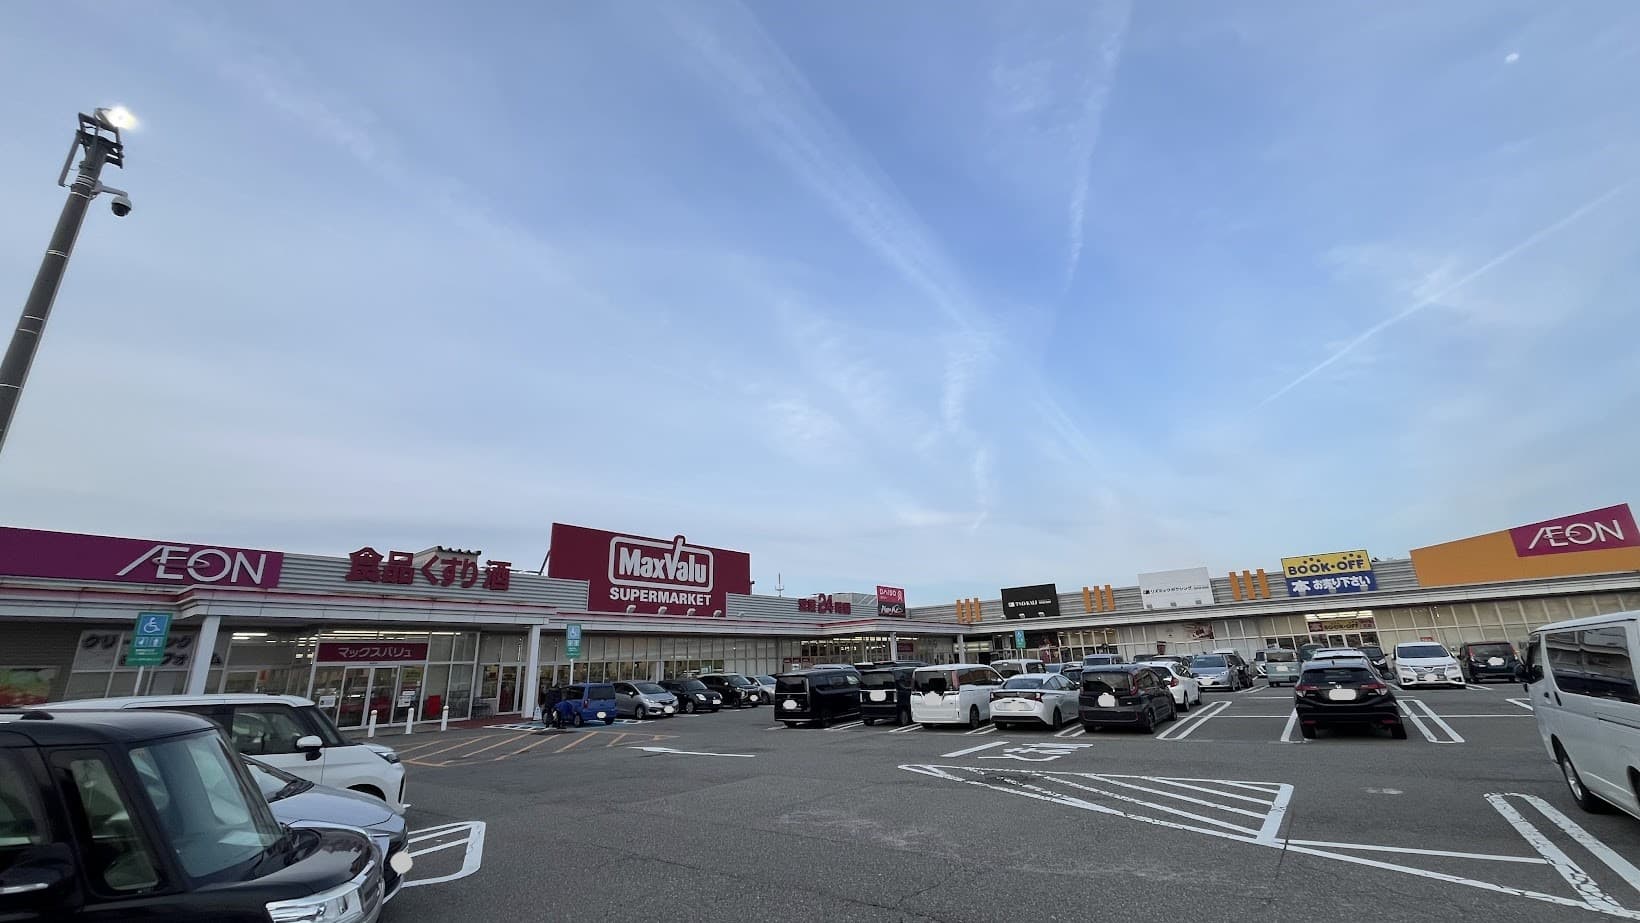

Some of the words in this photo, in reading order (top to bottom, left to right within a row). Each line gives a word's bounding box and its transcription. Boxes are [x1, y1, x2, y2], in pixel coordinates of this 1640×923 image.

[345, 546, 415, 585] 食品
[421, 554, 478, 589] くすり
[482, 560, 512, 591] 酒
[618, 537, 707, 584] MaxValu
[1312, 575, 1371, 590] お売り下さい
[609, 586, 712, 606] SUPERMARKET
[337, 646, 414, 658] マックスバリュ
